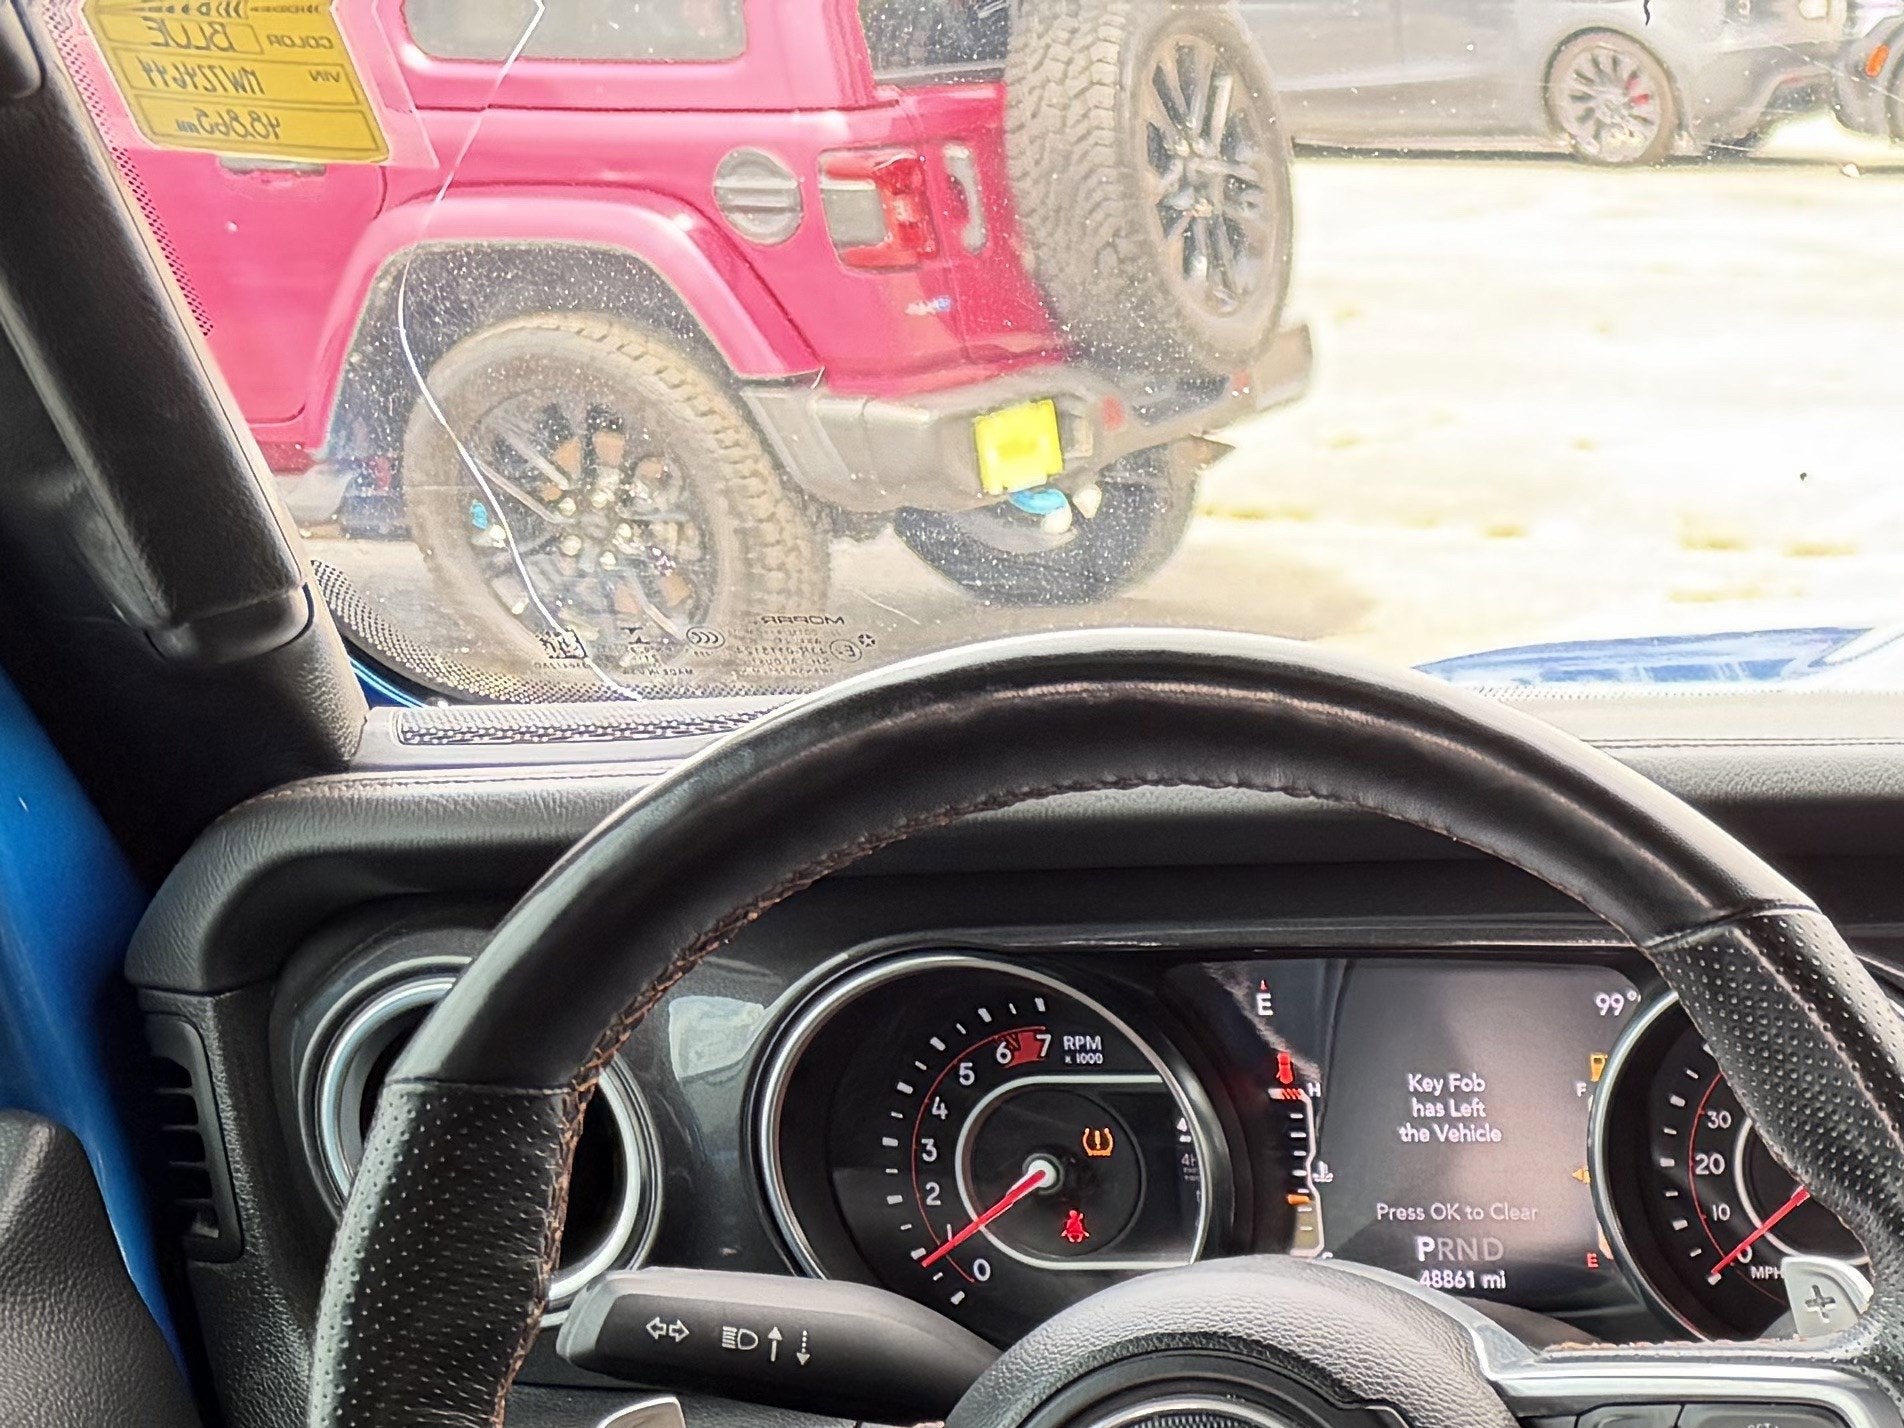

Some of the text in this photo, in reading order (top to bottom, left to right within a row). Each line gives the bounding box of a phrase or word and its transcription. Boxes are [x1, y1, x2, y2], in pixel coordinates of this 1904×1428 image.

[1256, 992, 1274, 1016] E
[995, 1042, 1012, 1064] 6
[1036, 1034, 1051, 1057] 7
[1063, 1035, 1102, 1051] RPM
[1075, 1052, 1104, 1065] 1000
[958, 1063, 976, 1086] 5
[1408, 1073, 1486, 1094] Key Fob
[1308, 1083, 1322, 1098] H
[1576, 1082, 1587, 1096] F
[931, 1097, 949, 1119] 4
[1411, 1099, 1487, 1118] has Left
[1706, 1110, 1732, 1129] 30
[1399, 1124, 1502, 1143] the Vehicle
[920, 1138, 937, 1161] 3
[1694, 1153, 1725, 1175] 20
[925, 1182, 942, 1206] 2
[1376, 1203, 1538, 1221] Press OK to Clear
[1711, 1205, 1731, 1221] 10
[1587, 1253, 1599, 1267] E
[1736, 1244, 1753, 1264] 0
[972, 1258, 991, 1281] 0
[1750, 1266, 1784, 1280] MPH
[1419, 1270, 1506, 1290] 48861 mi
